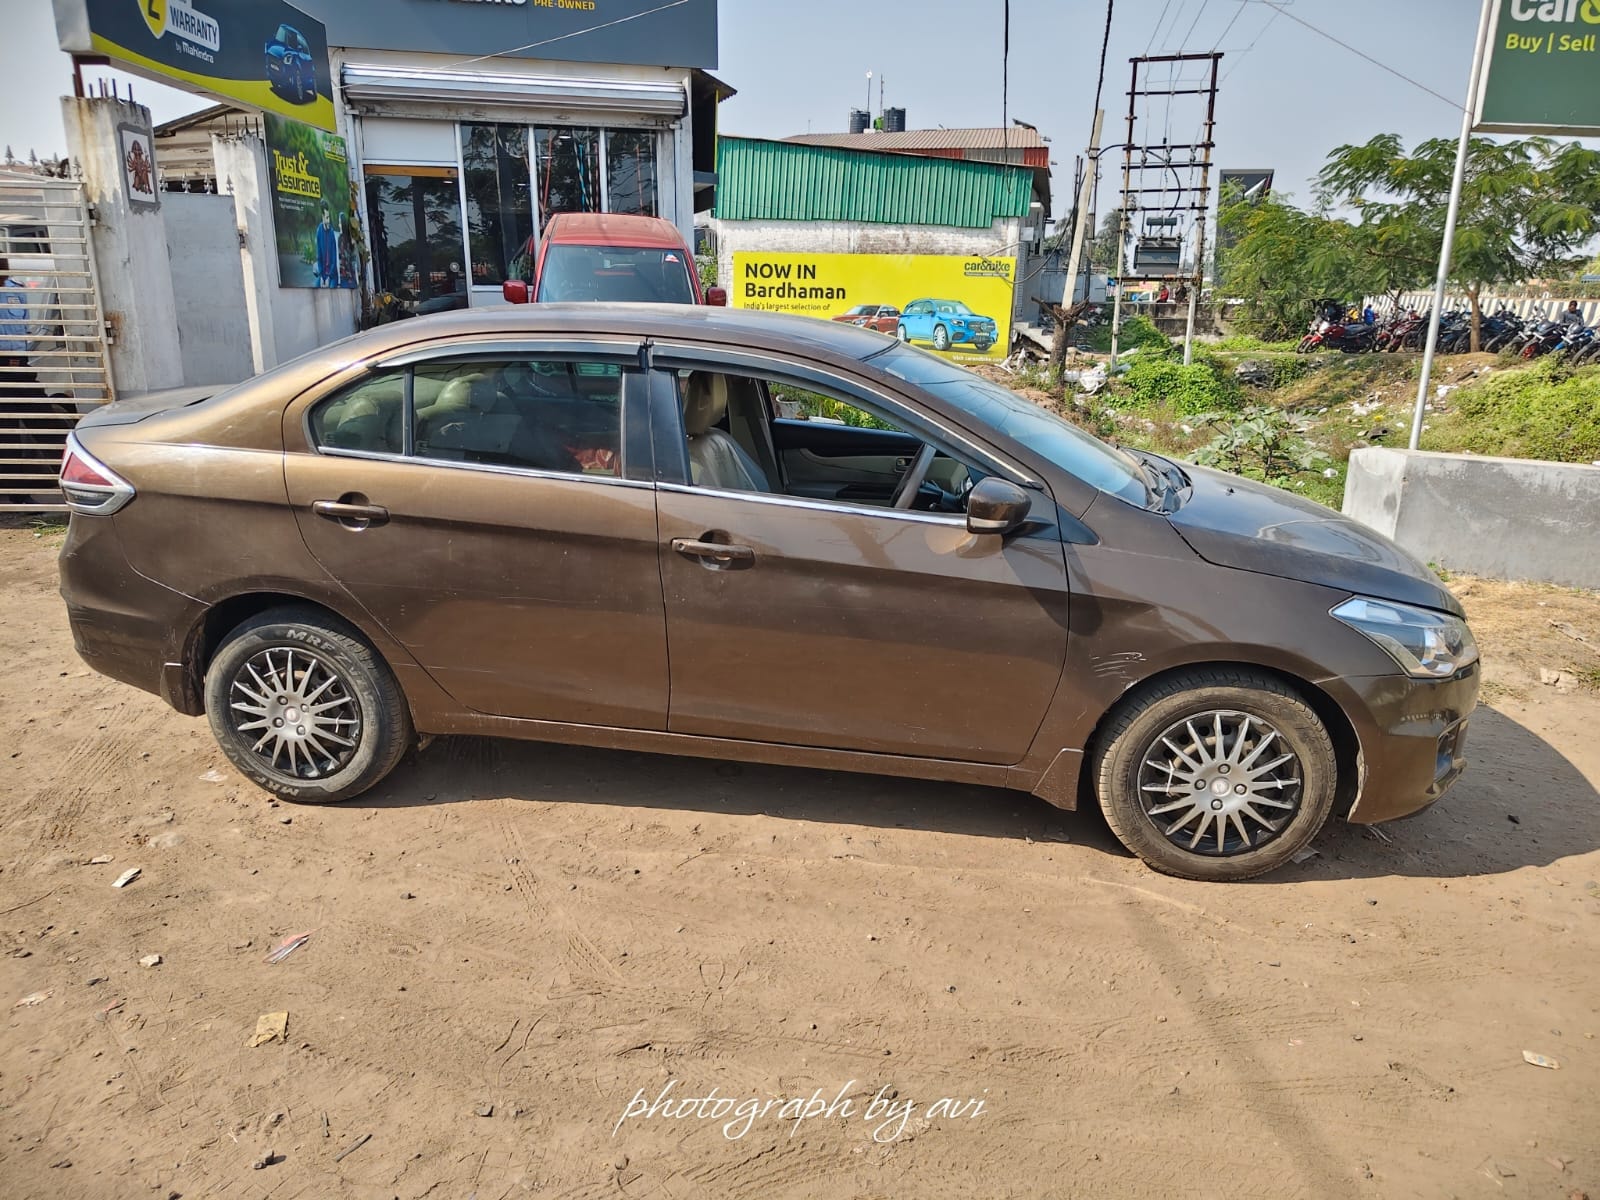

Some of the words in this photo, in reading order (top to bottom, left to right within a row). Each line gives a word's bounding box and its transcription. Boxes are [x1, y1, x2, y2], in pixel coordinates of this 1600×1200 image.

[534, 0, 595, 10] PRE-OWNED
[169, 6, 217, 45] WARRANTY
[1505, 33, 1543, 53] Buy
[1558, 34, 1596, 52] Sell
[272, 149, 296, 173] Trust
[298, 151, 309, 174] &
[276, 168, 320, 195] Assurance
[745, 263, 792, 279] NOW
[797, 264, 816, 279] IN
[745, 282, 846, 299] Bardhaman
[743, 302, 765, 310] India's
[766, 302, 790, 311] largest
[286, 628, 337, 653] MRF
